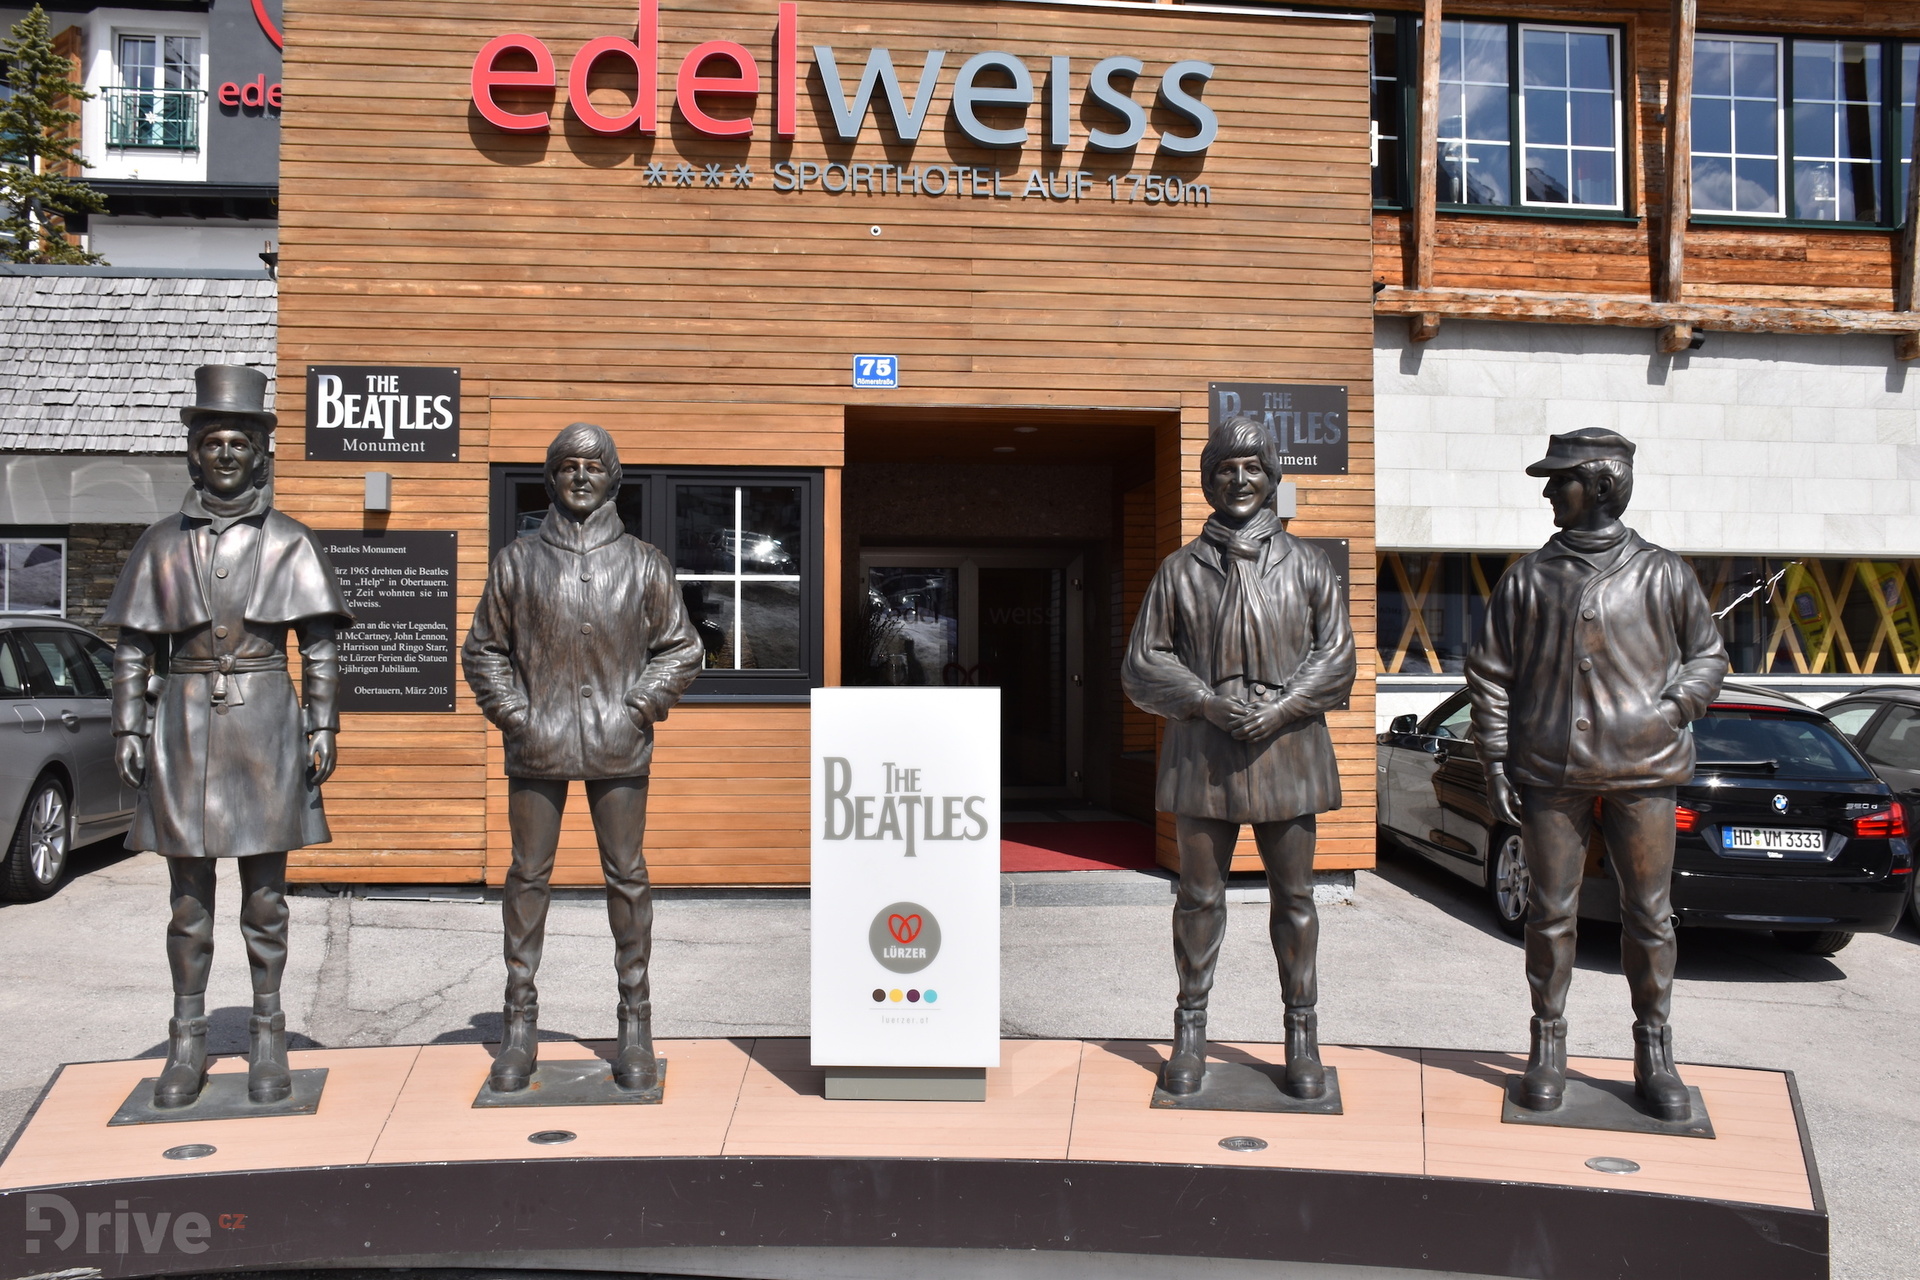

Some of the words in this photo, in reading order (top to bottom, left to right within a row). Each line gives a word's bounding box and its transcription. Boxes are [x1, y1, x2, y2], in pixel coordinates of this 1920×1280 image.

[470, 0, 1219, 157] edelweiss
[218, 73, 283, 107] ede
[773, 161, 1013, 196] SPORTHOTEL
[1023, 169, 1093, 199] AUF
[1107, 174, 1211, 203] 1750m
[860, 359, 892, 376] 75
[366, 375, 399, 393] THE
[316, 374, 453, 440] BEATLES
[1262, 392, 1292, 409] THE
[1218, 391, 1341, 453] BATLES
[343, 438, 426, 452] Monument
[330, 545, 360, 553] Beatles
[362, 545, 407, 554] Monument
[334, 567, 348, 575] ärz
[350, 567, 369, 575] 1965
[371, 567, 402, 576] drehten
[404, 567, 417, 575] die
[419, 567, 449, 576] Beatles
[388, 578, 397, 586] in
[400, 578, 449, 587] Obertauern.
[356, 588, 374, 597] Zeit
[379, 589, 415, 597] wohnten
[420, 589, 432, 597] sie
[437, 589, 448, 597] im
[378, 621, 390, 630] die
[392, 621, 406, 630] vier
[408, 621, 448, 632] Legenden,
[345, 632, 392, 643] McCartney,
[394, 632, 413, 641] John
[415, 633, 448, 642] Lennon,
[343, 643, 379, 651] Harrison
[381, 643, 397, 651] und
[399, 643, 424, 654] Ringo
[425, 643, 448, 653] Starr,
[350, 653, 376, 662] Lürzer
[378, 654, 403, 662] Ferien
[404, 654, 417, 662] die
[418, 654, 448, 663] Statuen
[380, 664, 420, 673] Jubiläum.
[354, 686, 403, 696] Obertauern,
[405, 686, 427, 695] März
[429, 686, 448, 695] 2015
[882, 762, 922, 794] THE
[823, 756, 988, 857] BEATLES
[1733, 829, 1752, 846] HD
[1764, 832, 1782, 847] VM
[1786, 833, 1821, 849] 3333
[883, 945, 926, 959] LÜRZER
[881, 1015, 929, 1025] luerzer.at
